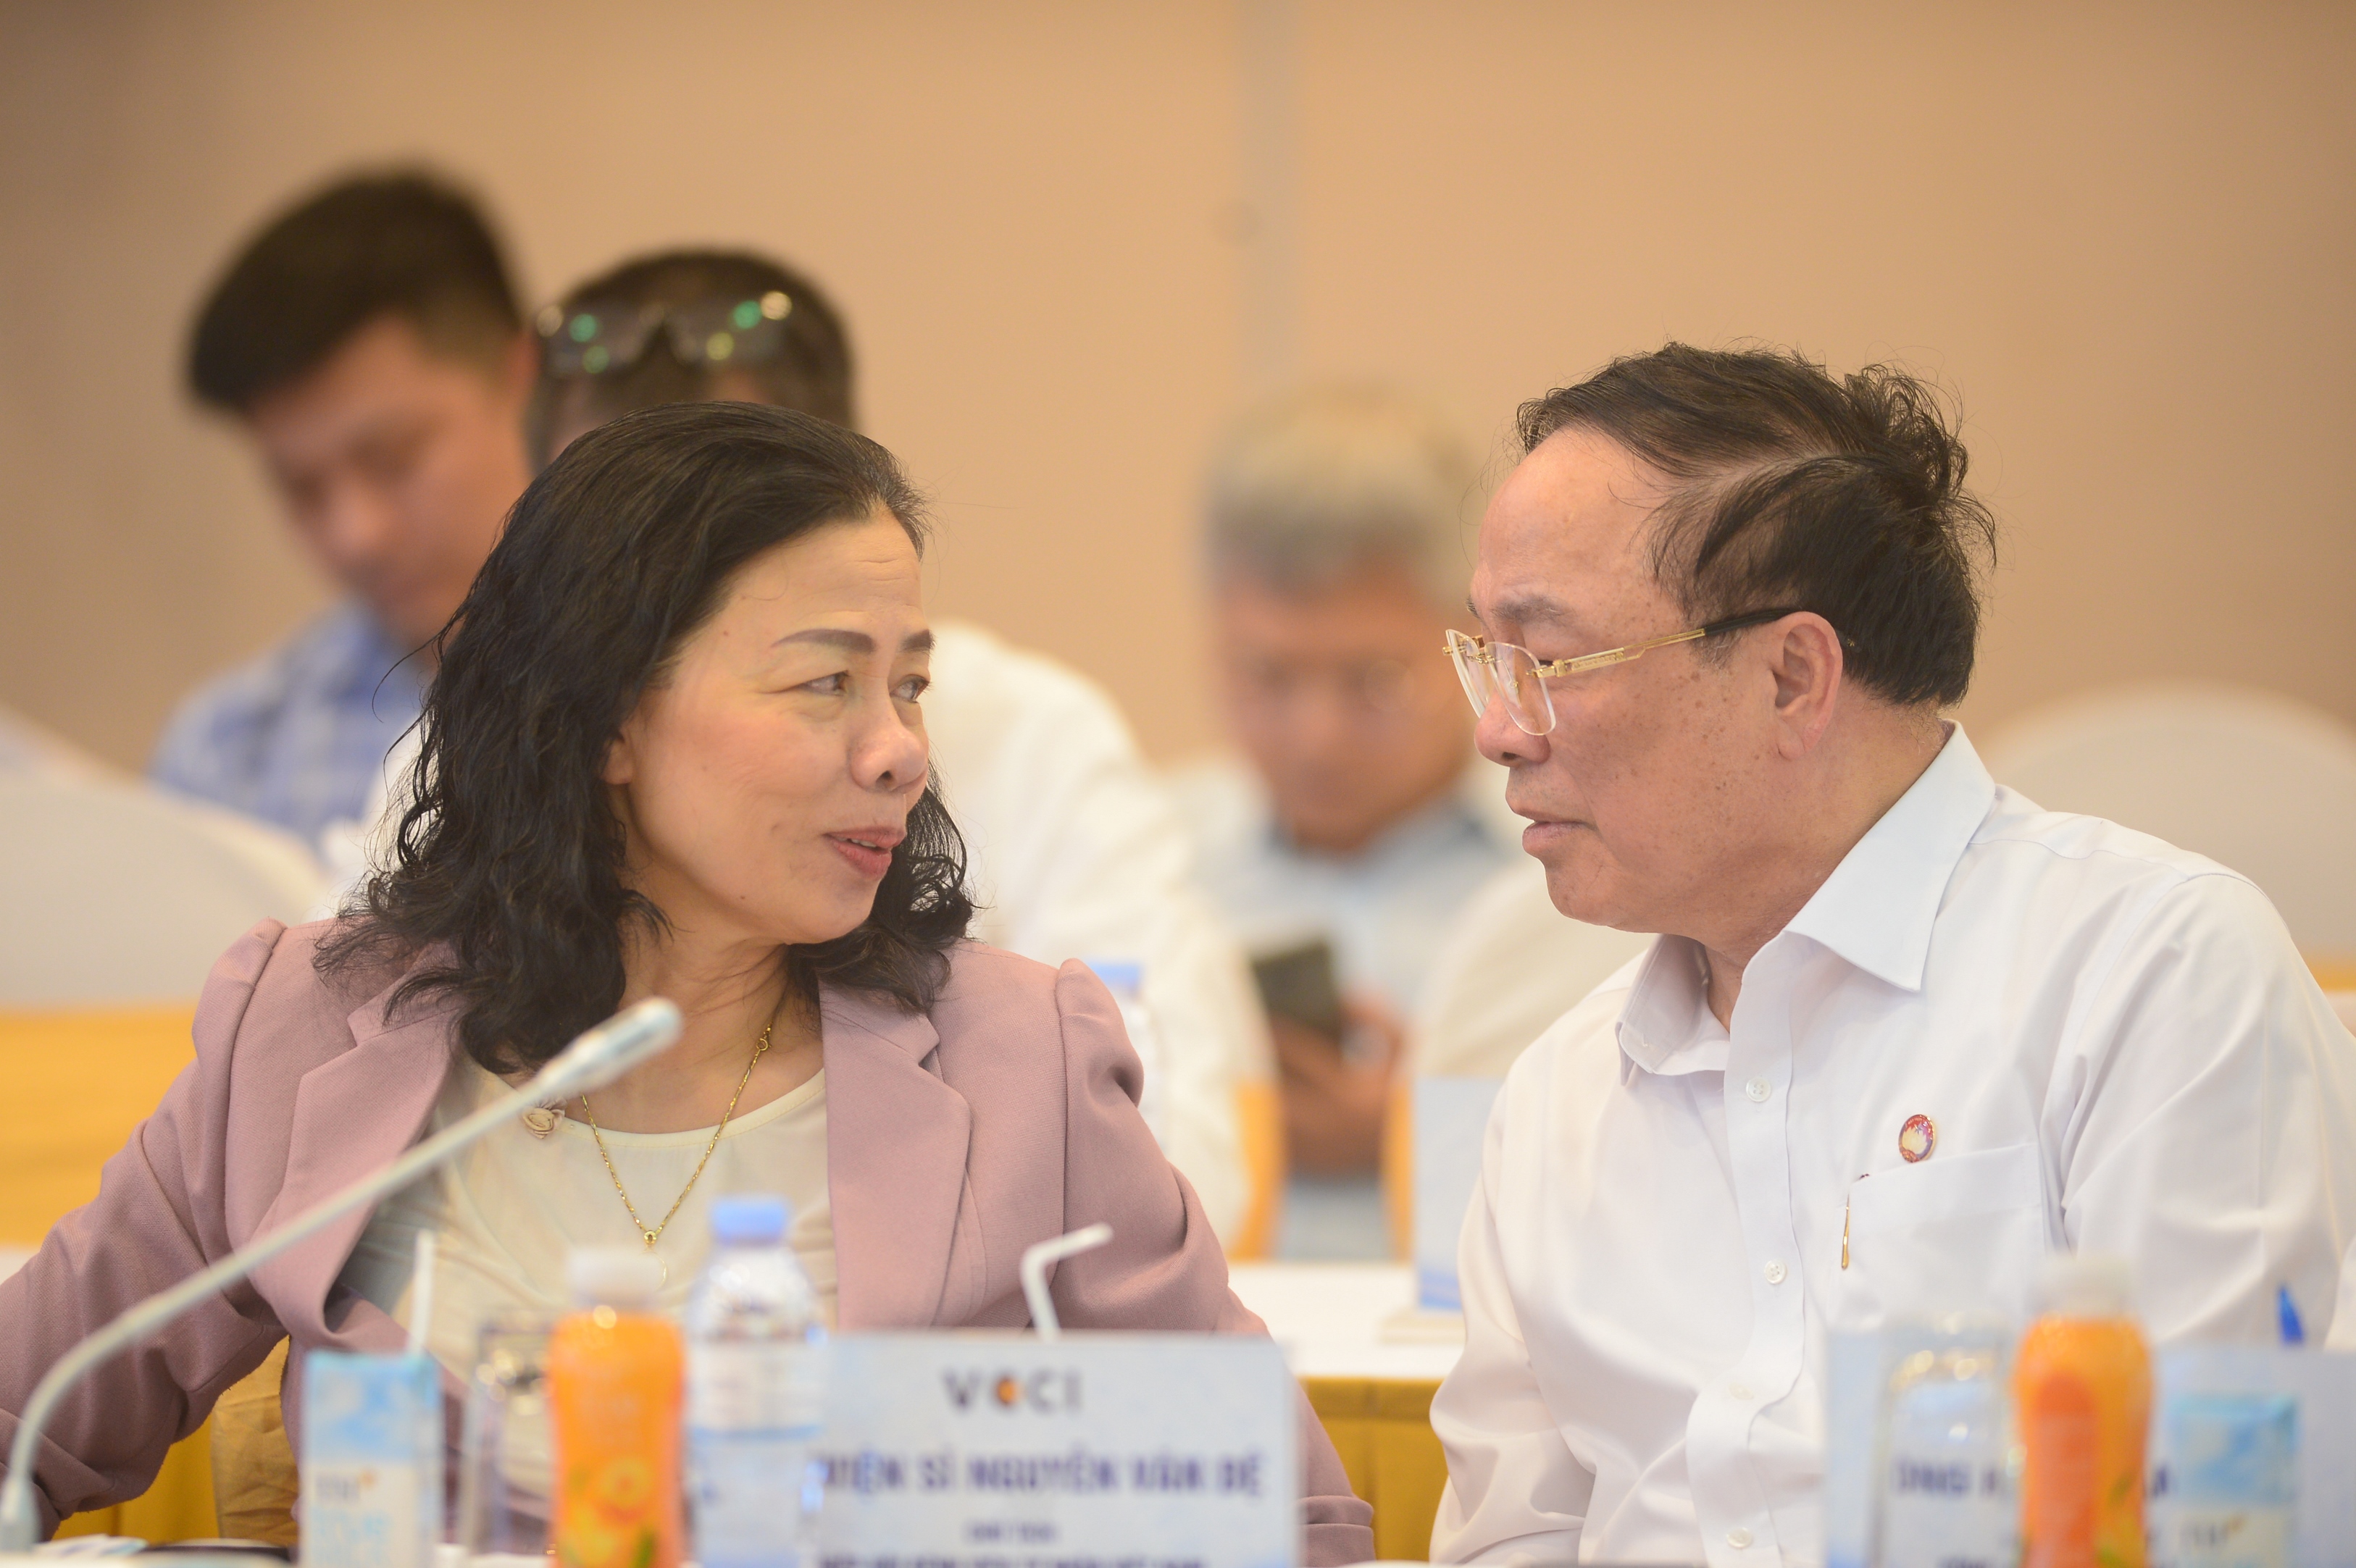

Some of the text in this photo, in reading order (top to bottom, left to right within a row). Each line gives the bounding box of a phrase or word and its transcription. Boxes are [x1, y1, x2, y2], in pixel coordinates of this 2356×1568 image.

[940, 1367, 1082, 1416] VCCI
[967, 1441, 1119, 1496] NGUYỄN
[1129, 1446, 1204, 1495] VĂN
